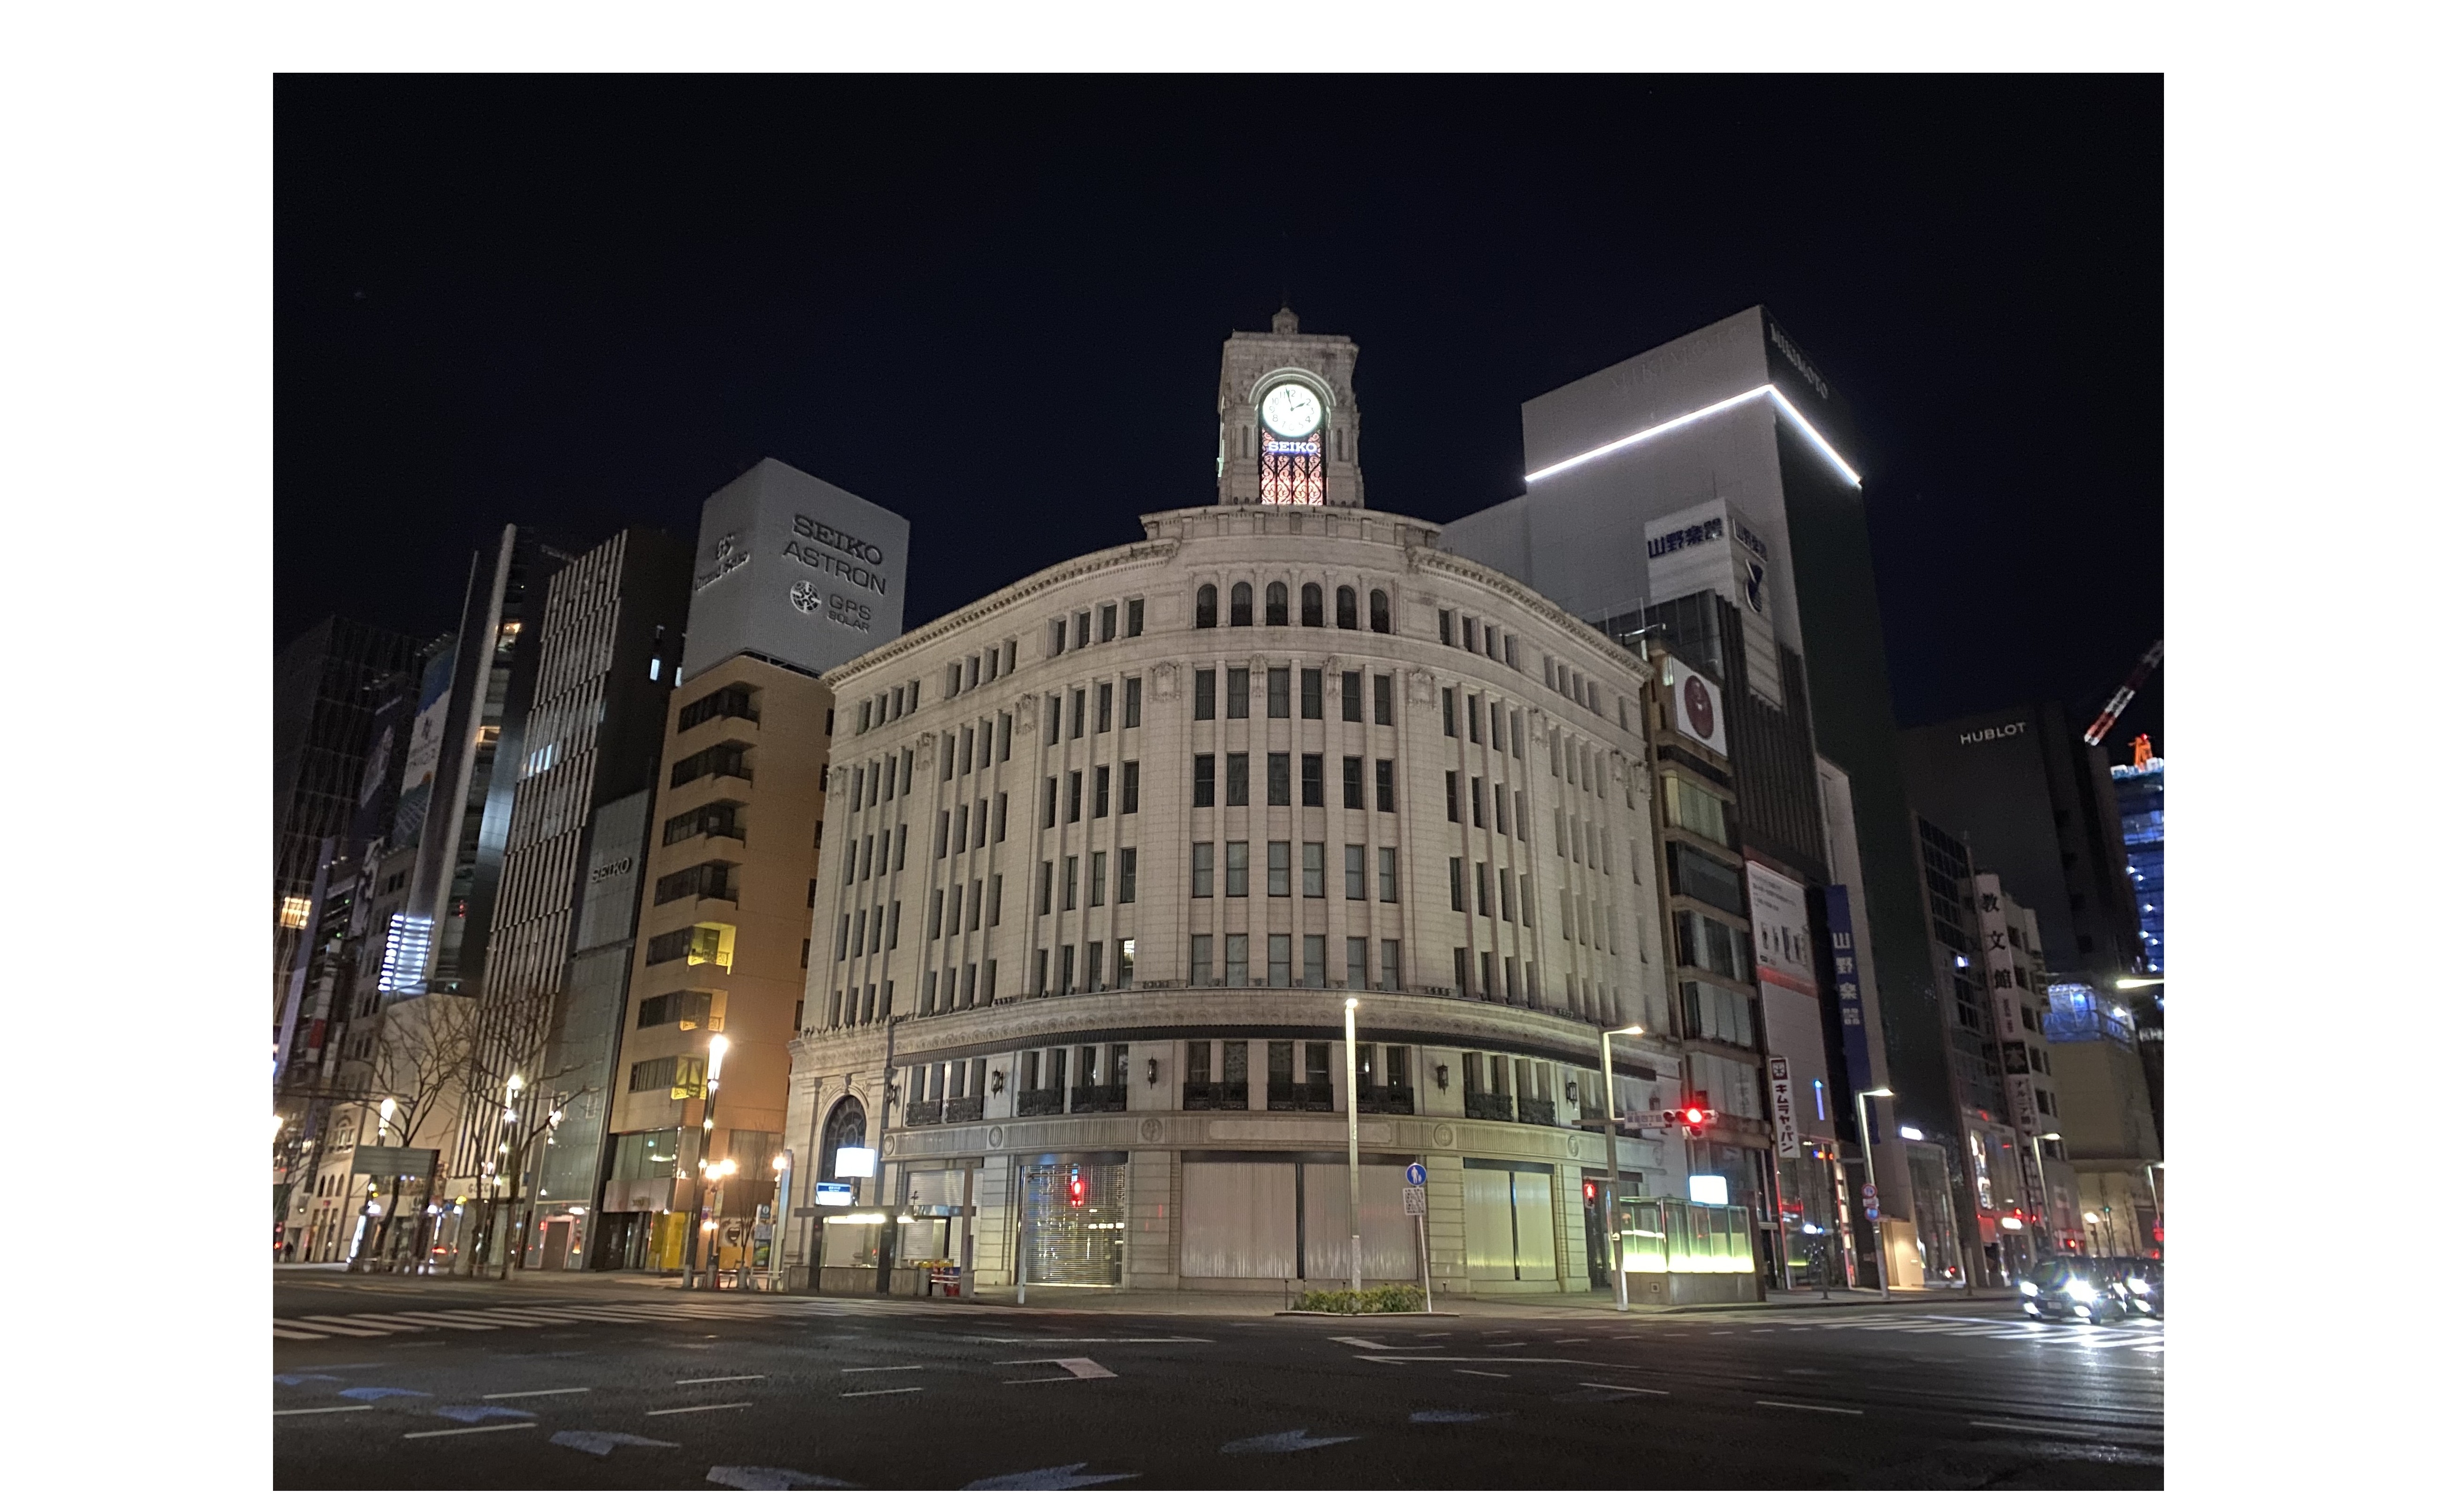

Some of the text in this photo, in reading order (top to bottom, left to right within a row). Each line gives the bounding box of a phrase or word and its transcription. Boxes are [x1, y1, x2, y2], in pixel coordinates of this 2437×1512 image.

[1268, 441, 1318, 453] SEIKO
[793, 515, 882, 565] SEIKO
[782, 541, 886, 596] ASTRON
[829, 593, 872, 621] GPS
[827, 610, 869, 633] SOLAR
[1960, 722, 2027, 745] HUBLOT
[592, 858, 633, 883] SEIKO
